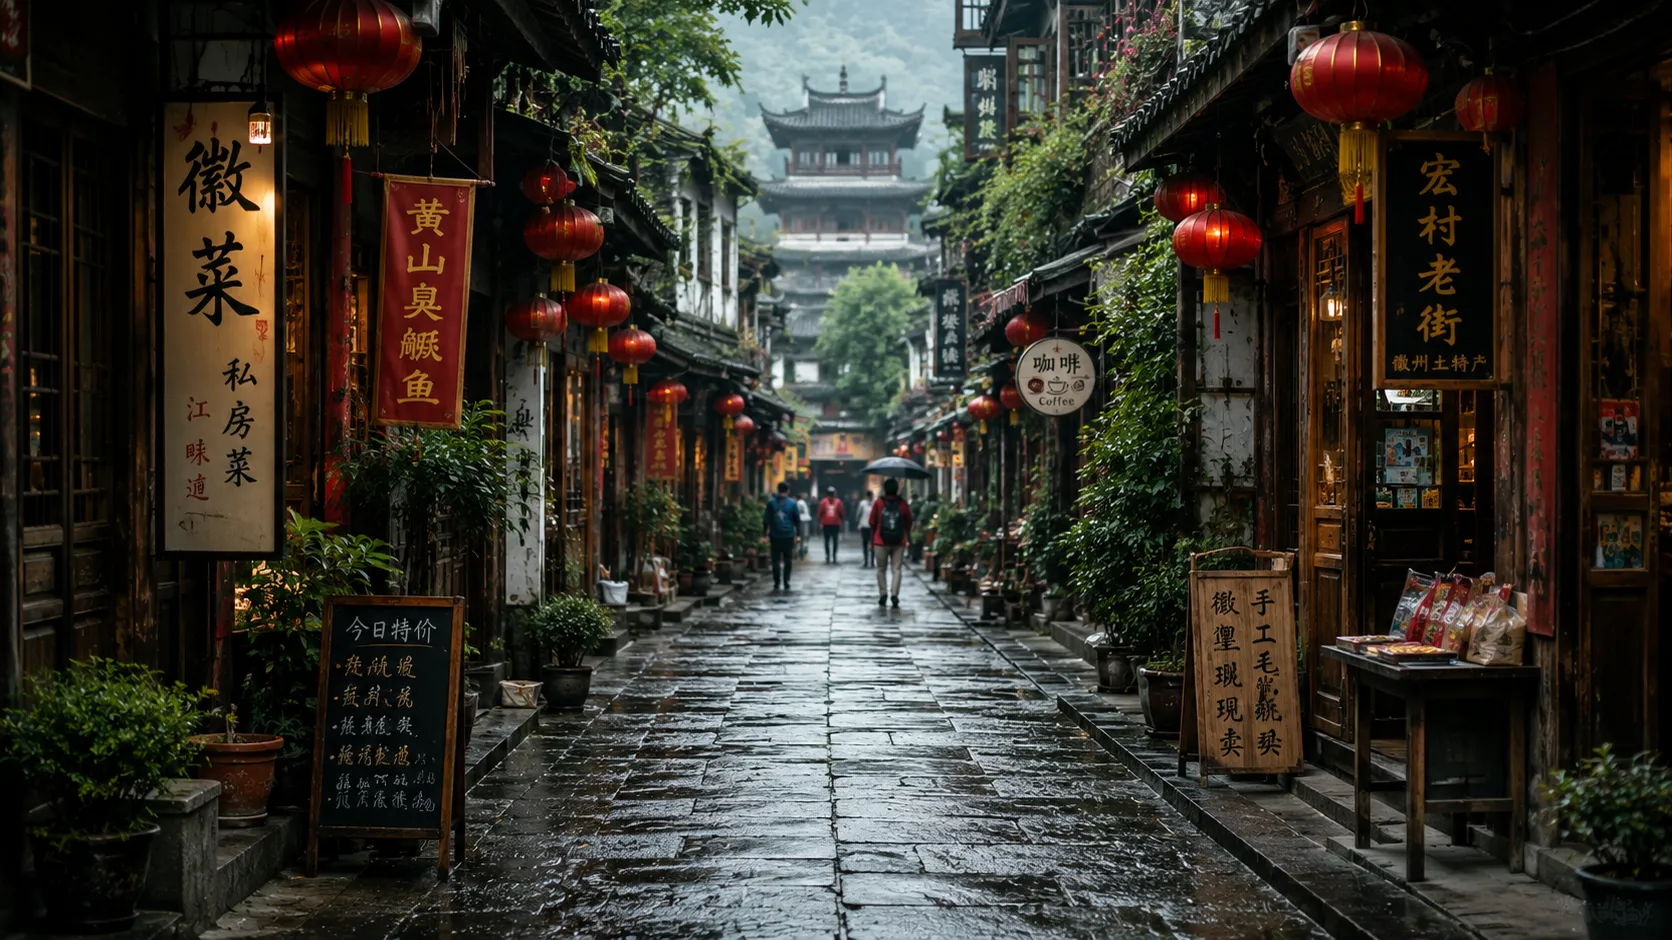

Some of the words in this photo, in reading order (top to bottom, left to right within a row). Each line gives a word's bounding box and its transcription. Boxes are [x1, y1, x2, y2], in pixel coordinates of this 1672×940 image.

[178, 138, 260, 326] 徽菜
[1417, 152, 1462, 346] 宏村老街
[1033, 353, 1081, 374] 咖啡
[1038, 396, 1075, 406] Coffee
[222, 357, 258, 487] 私房菜
[345, 616, 437, 643] 今日特价
